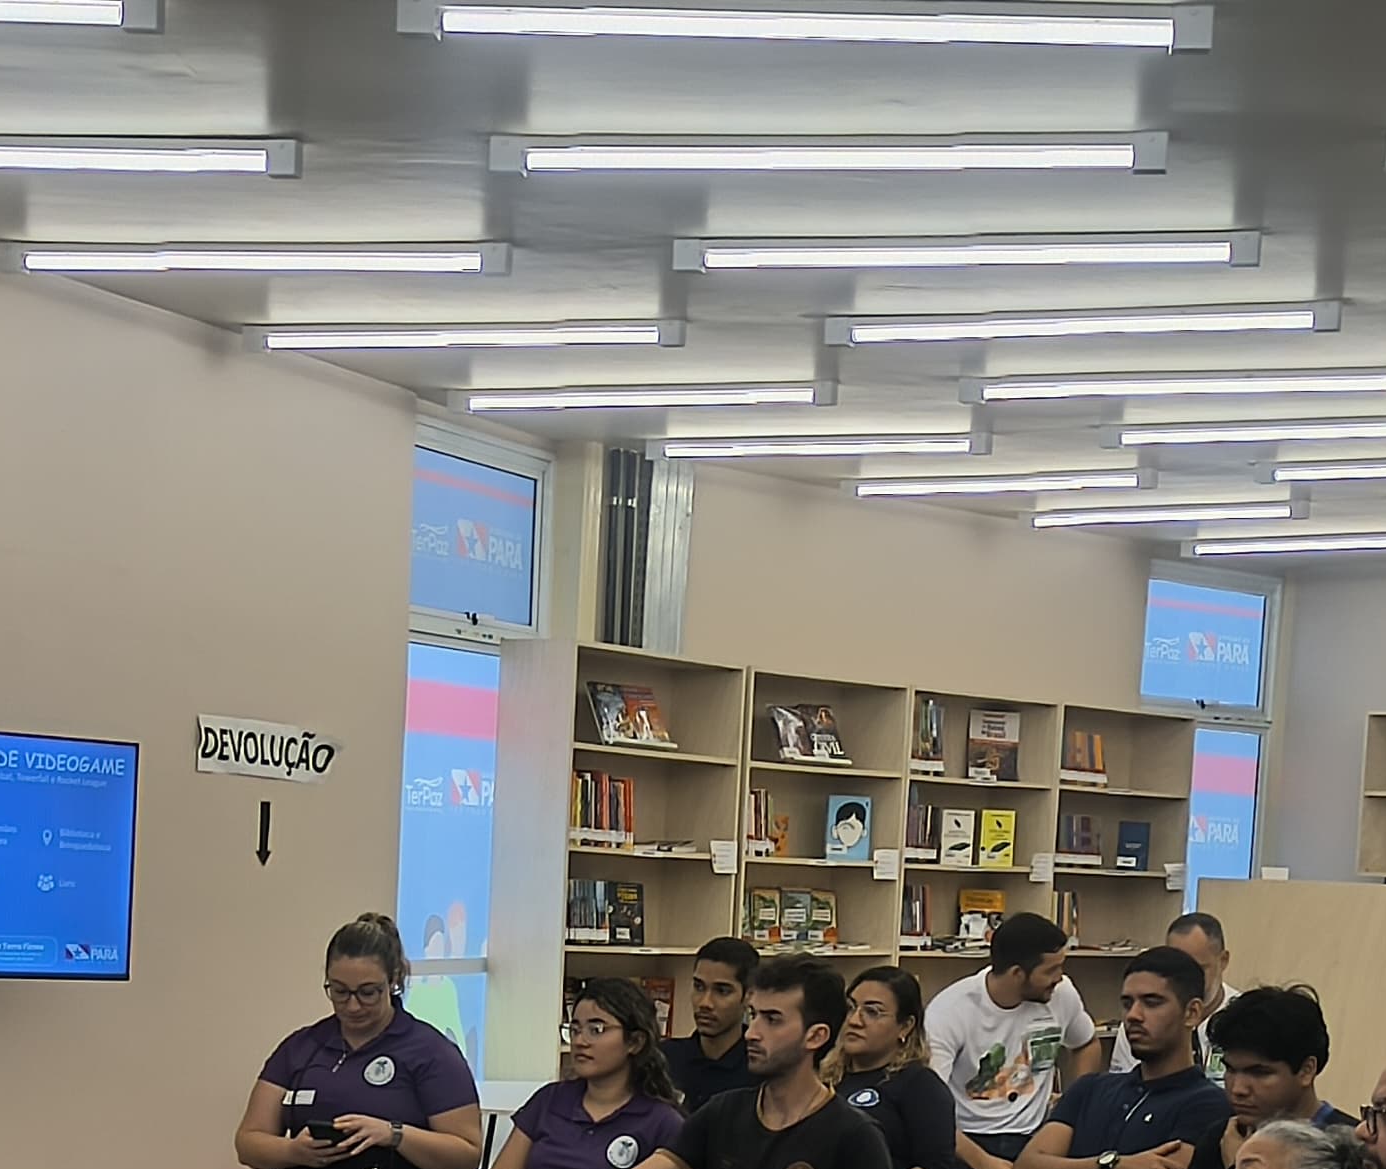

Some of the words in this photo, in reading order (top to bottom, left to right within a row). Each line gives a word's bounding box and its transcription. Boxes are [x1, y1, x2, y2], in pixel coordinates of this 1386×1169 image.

[201, 727, 335, 776] DEVOLUÇÃO
[25, 752, 125, 776] VIDEOGAME
[405, 784, 443, 807] TerPaz
